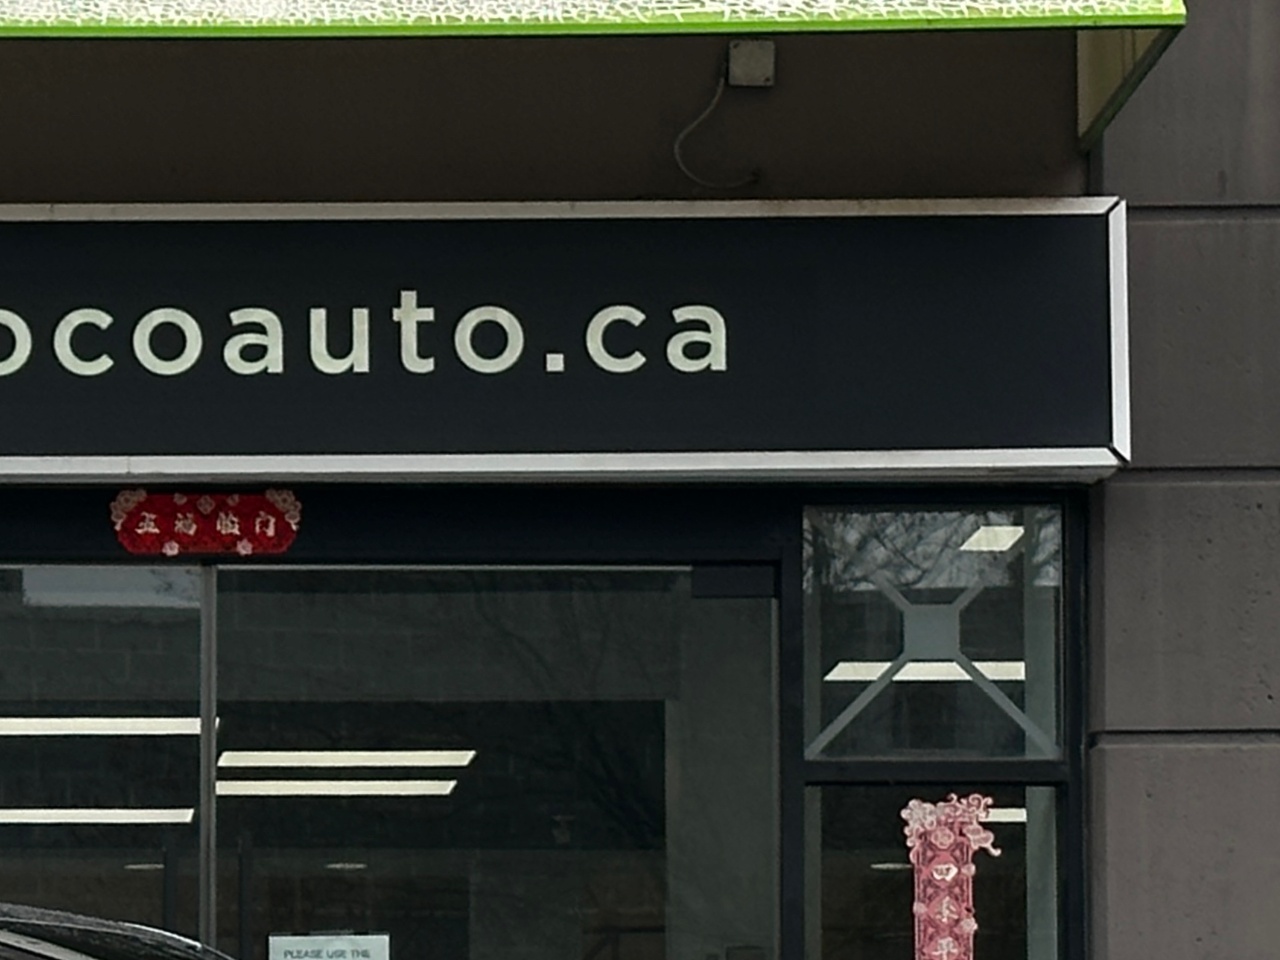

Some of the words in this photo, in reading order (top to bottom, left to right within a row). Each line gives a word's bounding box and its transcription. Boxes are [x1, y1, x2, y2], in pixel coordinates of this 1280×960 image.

[283, 949, 323, 959] PLEASE
[326, 949, 347, 959] USE
[350, 949, 370, 959] THE
